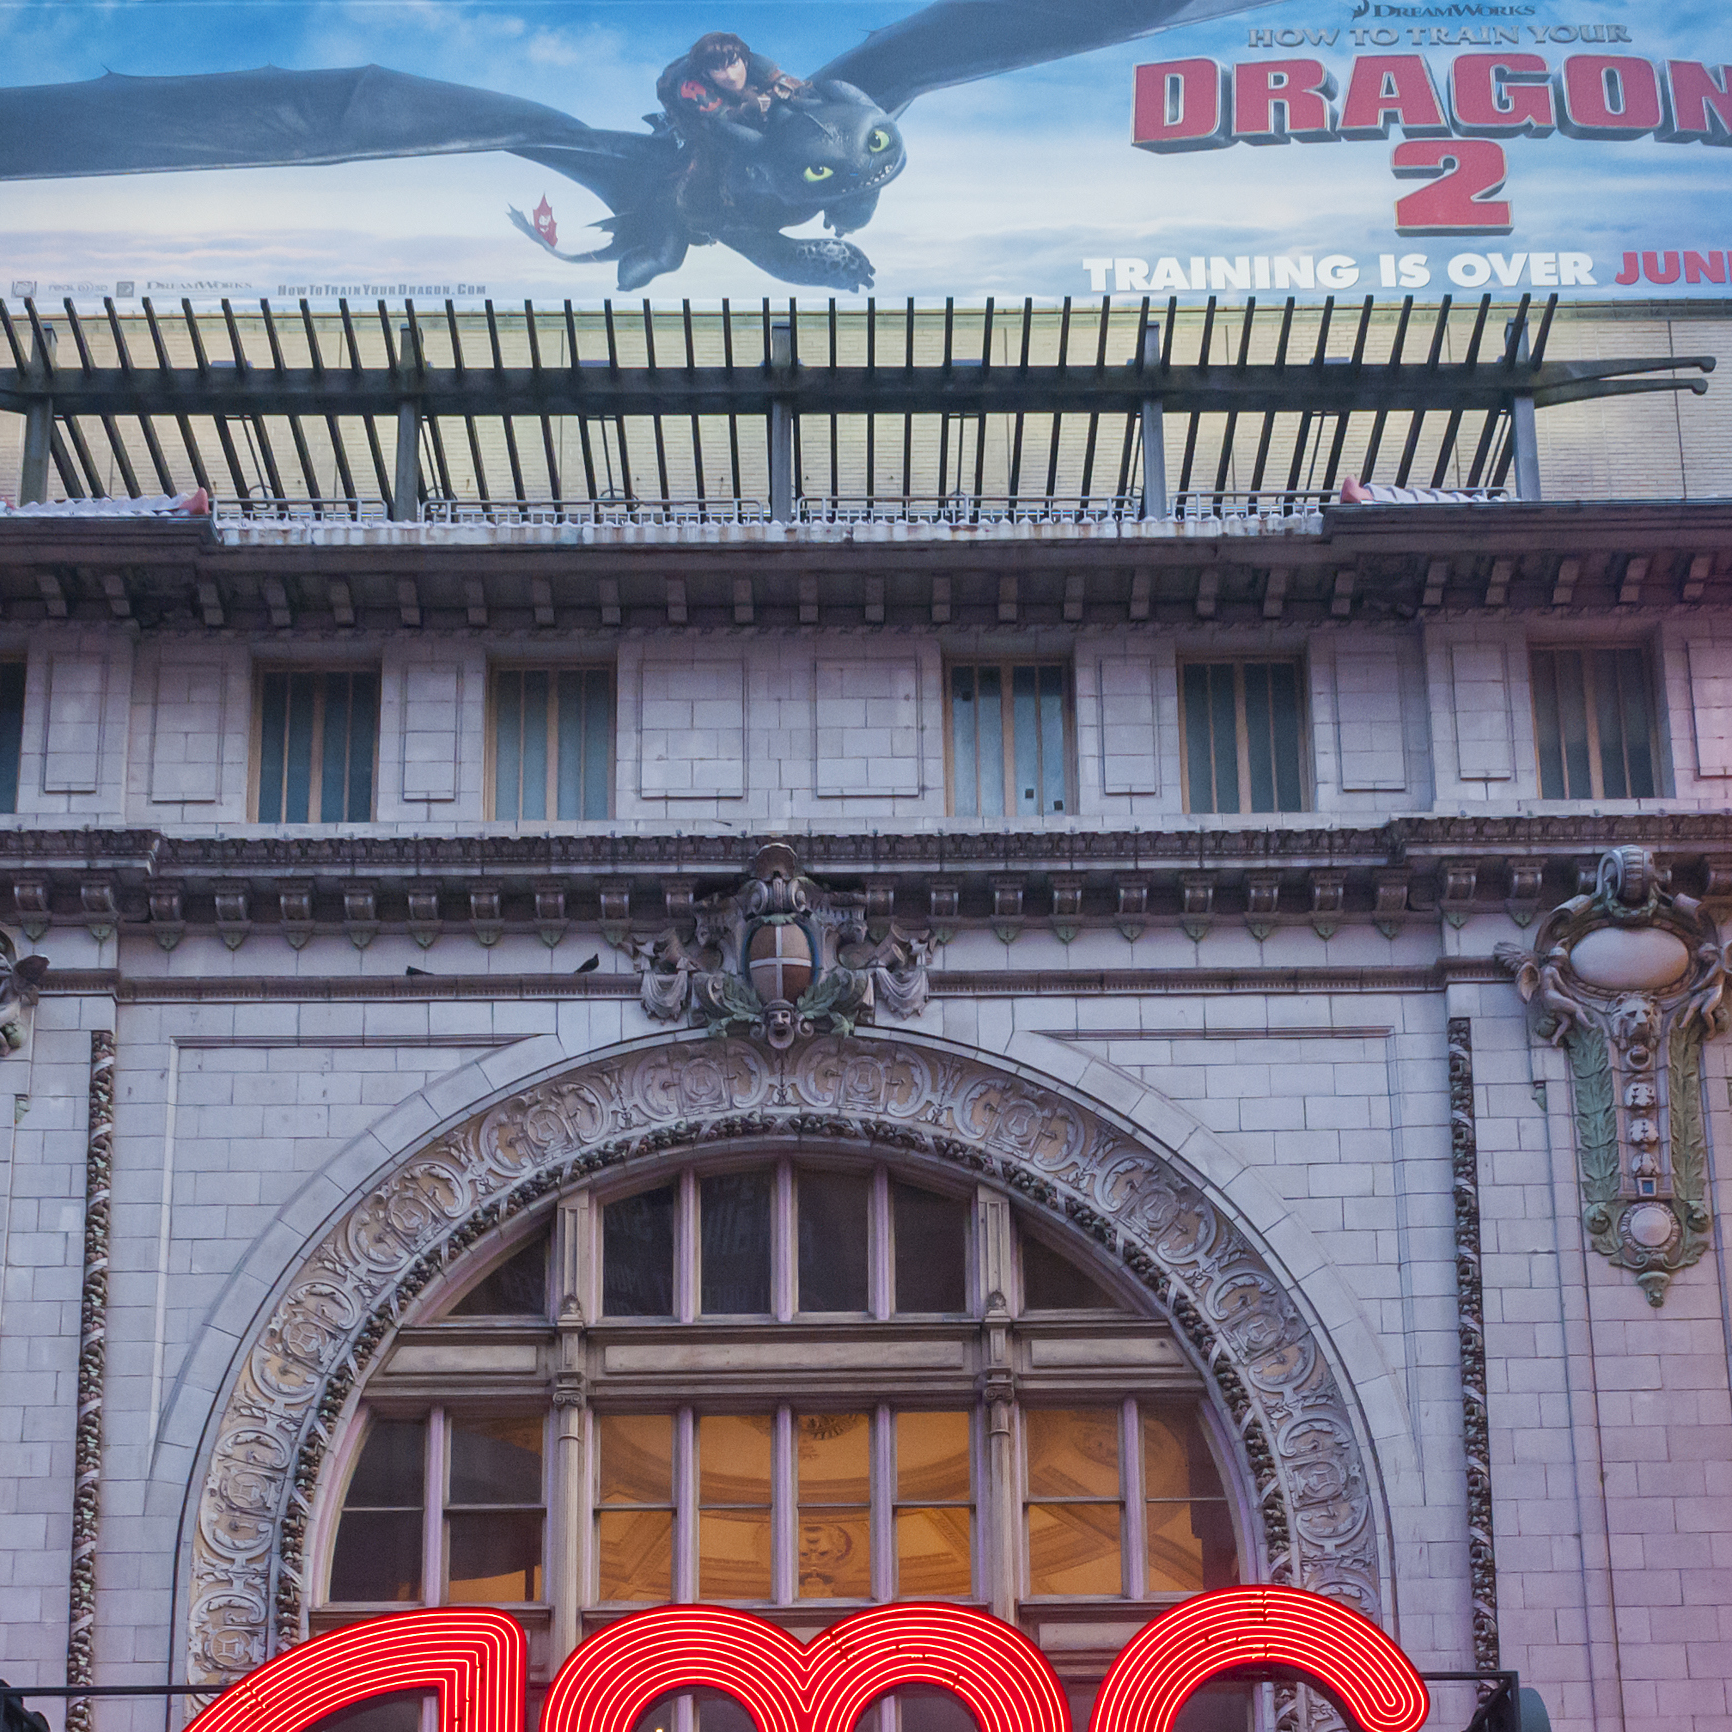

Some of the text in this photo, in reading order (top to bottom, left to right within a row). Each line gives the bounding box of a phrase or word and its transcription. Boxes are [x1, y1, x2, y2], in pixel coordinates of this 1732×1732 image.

[1248, 24, 1632, 48] HOW TO TRAIN YOUR
[1390, 137, 1513, 237] 2
[1083, 254, 1359, 293] TRAINING
[1380, 254, 1431, 289] IS
[1447, 251, 1597, 289] OVER
